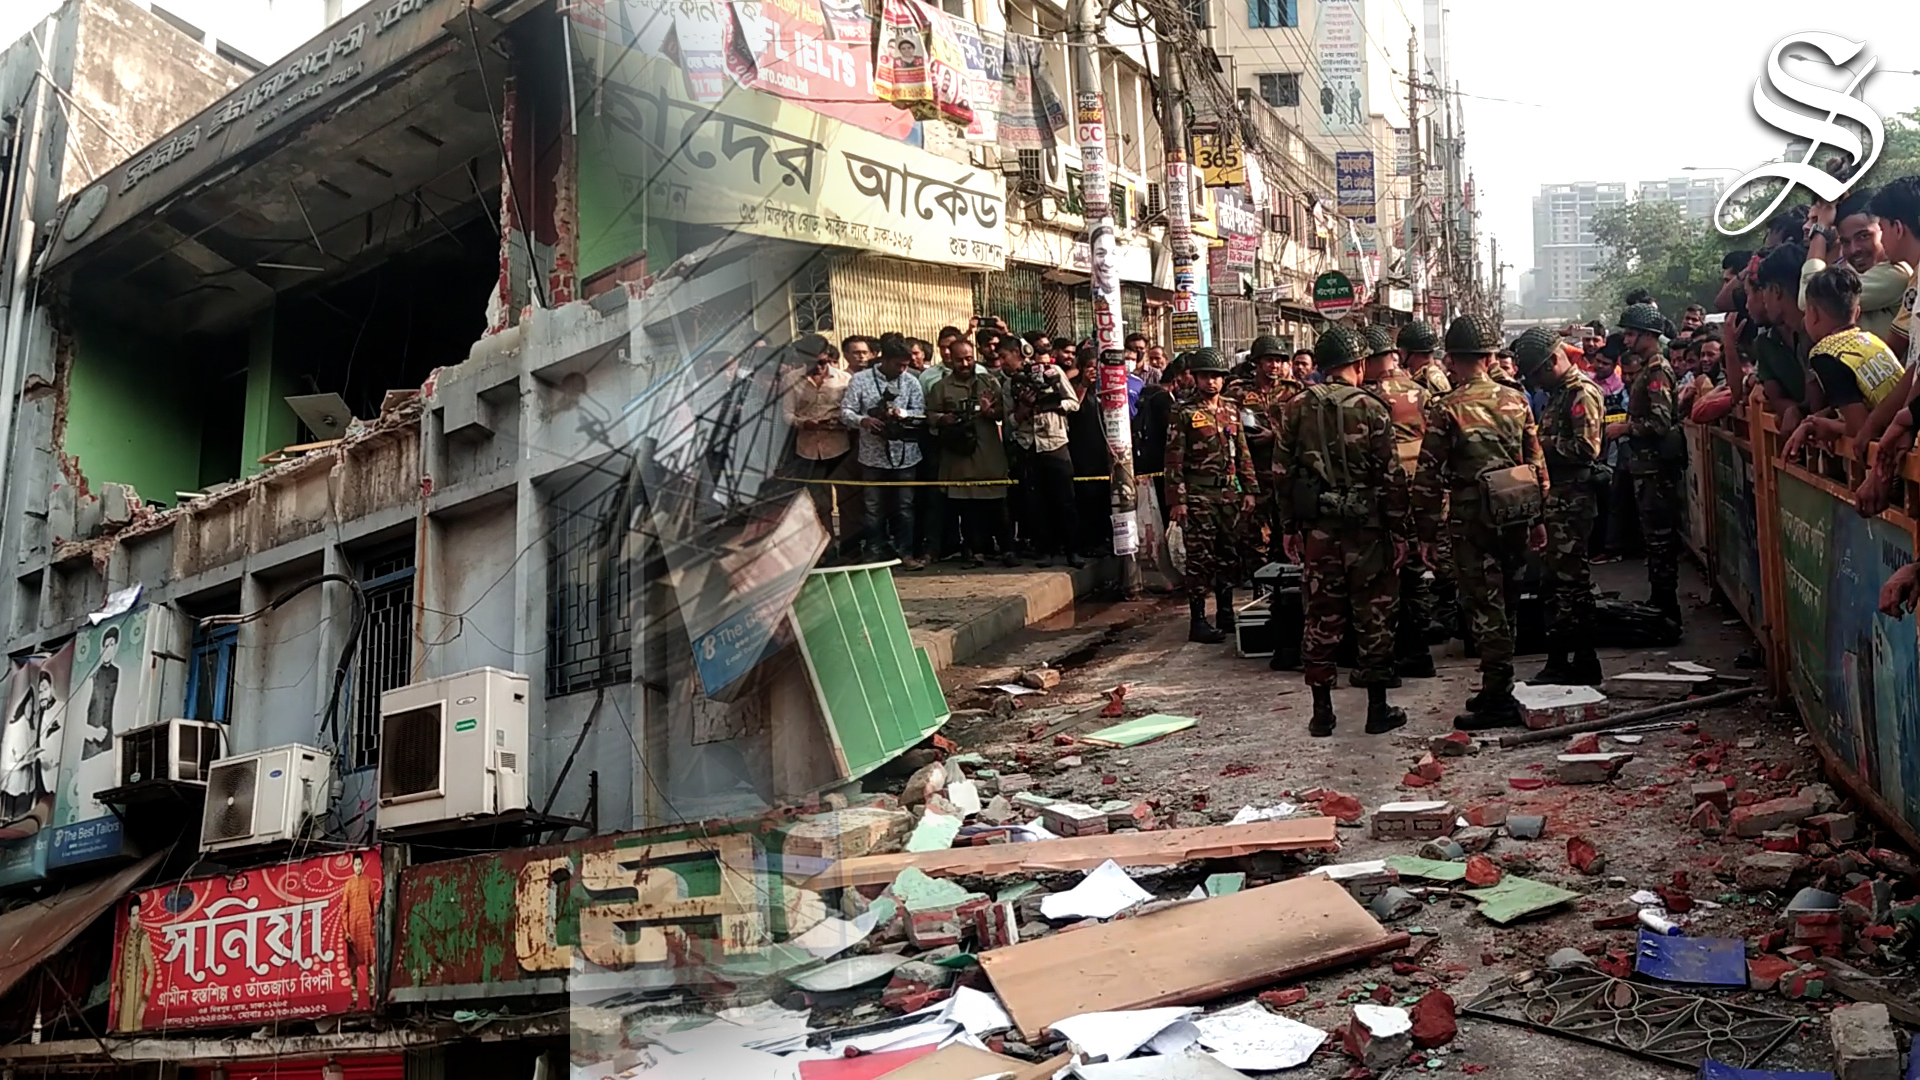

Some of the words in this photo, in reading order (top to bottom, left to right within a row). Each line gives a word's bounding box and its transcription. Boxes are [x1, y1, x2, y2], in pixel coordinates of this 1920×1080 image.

[795, 30, 857, 88] IELTS
[841, 150, 1004, 229] আর্কেড
[764, 199, 797, 235] মিরপুর
[971, 238, 1003, 264] ফ্যাশন
[1856, 349, 1900, 392] HAS
[717, 624, 743, 646] The
[64, 830, 77, 842] The
[78, 826, 95, 840] Best
[96, 821, 120, 836] Tailors
[161, 896, 335, 983] সনিয়া
[157, 985, 188, 1008] গ্রামীন
[232, 985, 241, 999] ও
[246, 977, 297, 999] তাঁতজাত
[300, 970, 335, 995] বিপনী
